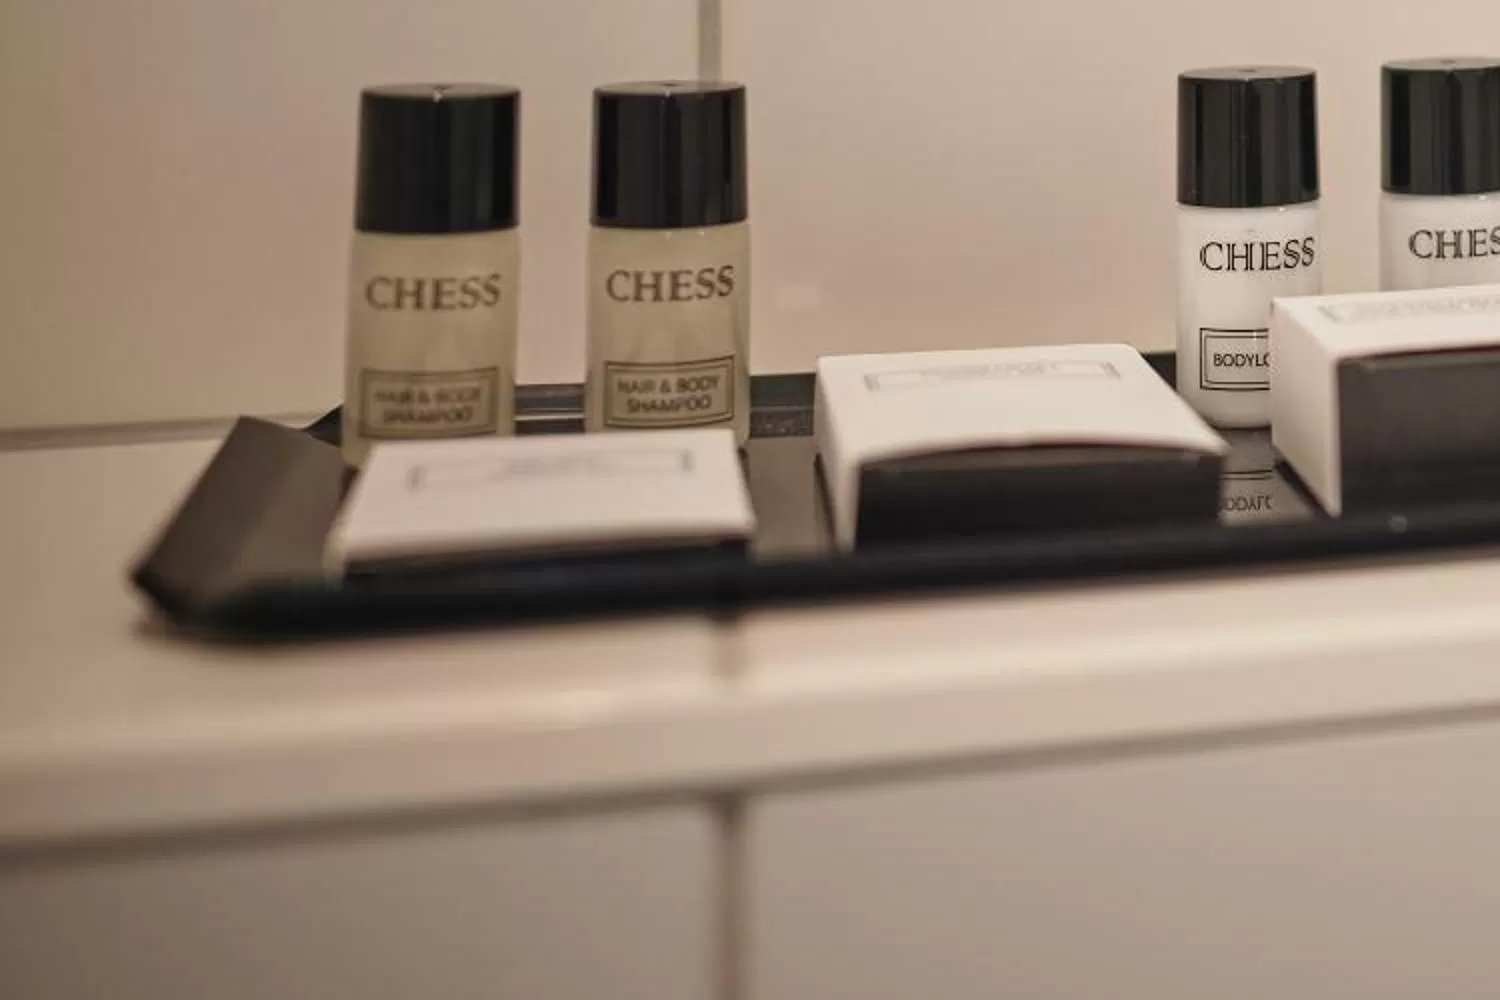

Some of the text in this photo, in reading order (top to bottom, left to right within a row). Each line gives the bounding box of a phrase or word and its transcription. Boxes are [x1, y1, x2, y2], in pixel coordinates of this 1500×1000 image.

[1200, 236, 1316, 272] CHESS
[364, 272, 503, 312] CHESS
[605, 265, 735, 303] CHESS
